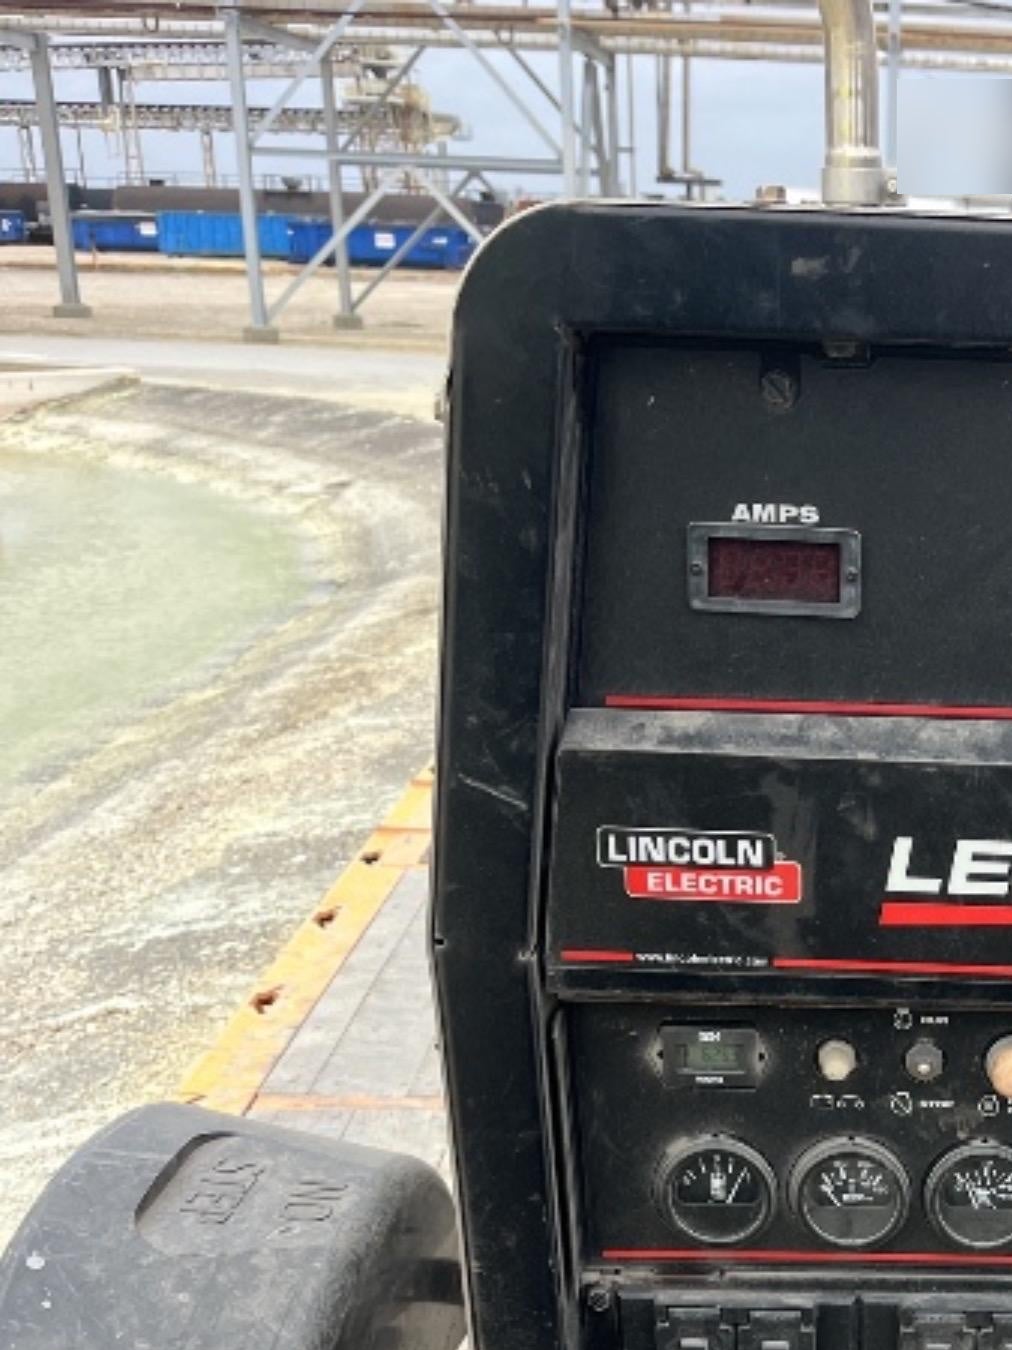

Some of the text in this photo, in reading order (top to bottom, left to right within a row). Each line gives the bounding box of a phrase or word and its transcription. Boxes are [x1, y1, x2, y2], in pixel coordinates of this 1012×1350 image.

[731, 502, 821, 524] AMPS
[607, 834, 764, 867] LINCOLN
[647, 872, 784, 897] ELECTRIC
